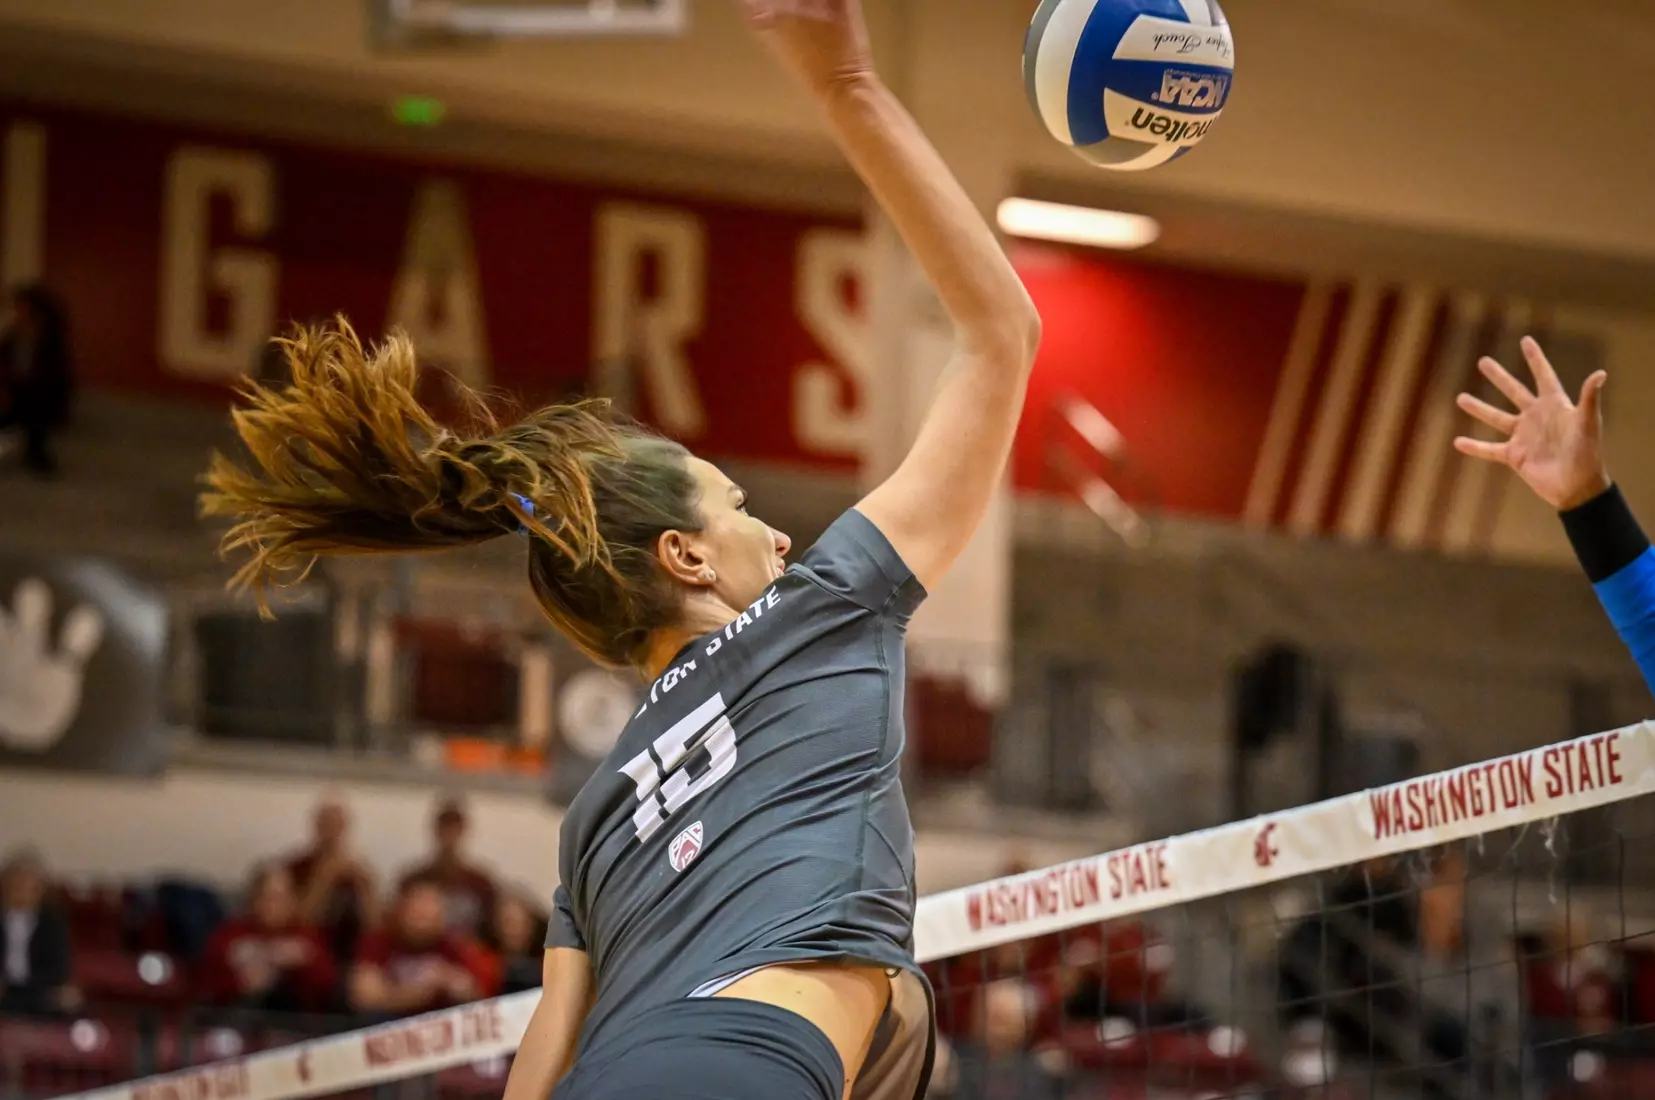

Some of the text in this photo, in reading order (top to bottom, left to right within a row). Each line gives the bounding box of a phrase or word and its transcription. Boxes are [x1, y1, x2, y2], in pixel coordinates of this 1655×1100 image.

[1152, 32, 1201, 54] Touch
[1159, 73, 1228, 108] NCAA
[617, 692, 737, 844] 15
[1369, 732, 1623, 840] WASHINGTON STATE
[965, 845, 1171, 931] WASHINGTON STATE
